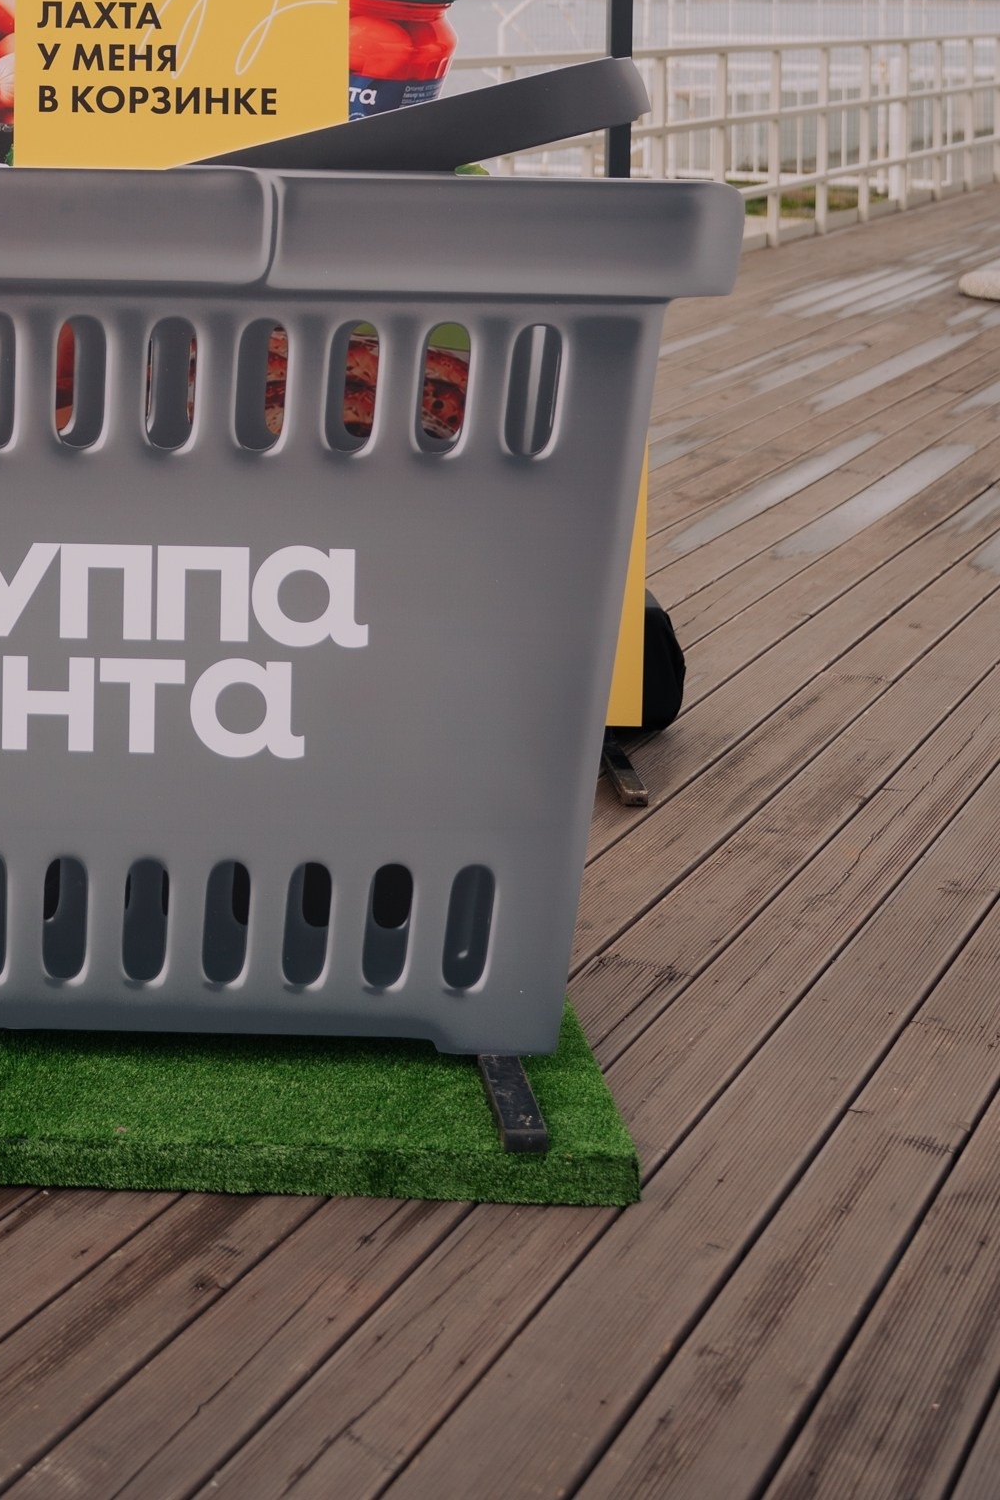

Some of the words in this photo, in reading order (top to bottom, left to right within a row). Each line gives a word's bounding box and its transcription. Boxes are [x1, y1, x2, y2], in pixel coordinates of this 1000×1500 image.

[36, 0, 163, 31] ЛАХТА
[37, 42, 62, 72] У
[71, 43, 178, 73] МЕНЯ
[37, 85, 60, 114] В
[71, 85, 278, 117] КОРЗИНКЕ
